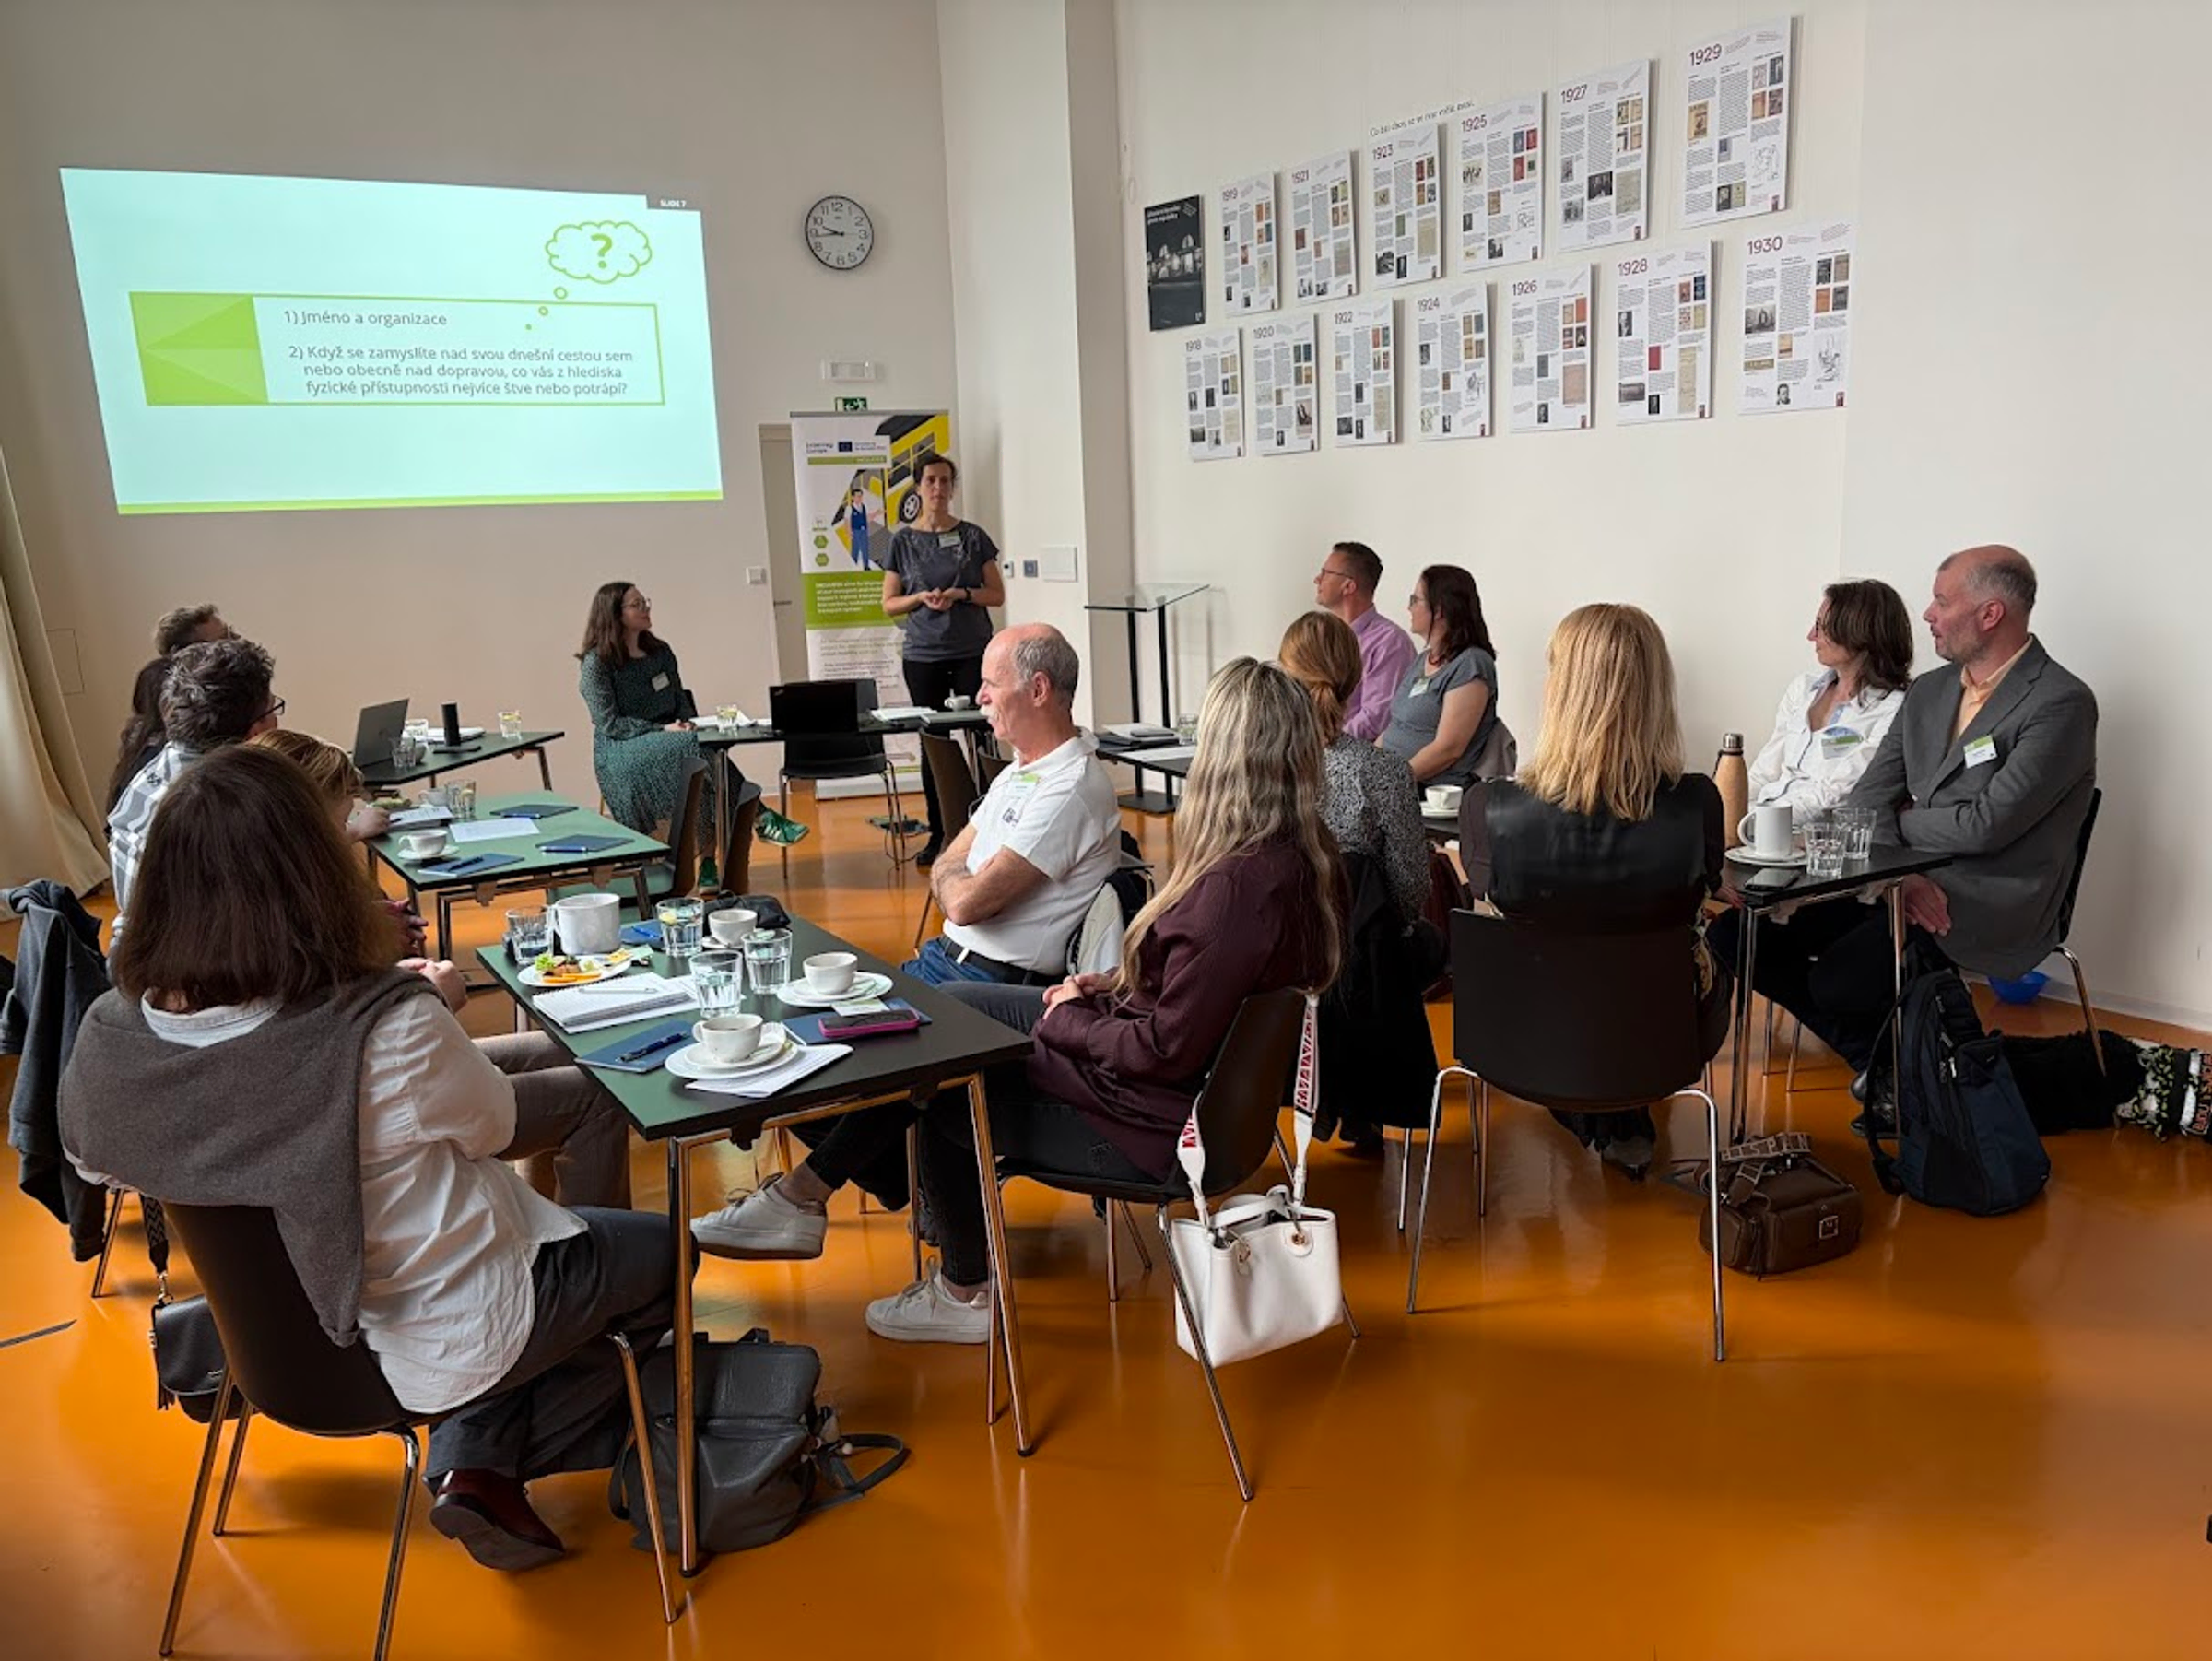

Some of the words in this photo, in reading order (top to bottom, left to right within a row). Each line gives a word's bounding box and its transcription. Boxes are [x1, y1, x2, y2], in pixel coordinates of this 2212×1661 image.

[1690, 43, 1722, 66] 1929
[1561, 84, 1587, 104] 1927
[1462, 114, 1487, 133] 1925
[1372, 144, 1394, 160] 1923
[1292, 170, 1309, 184] 1921
[820, 205, 830, 216] 11
[831, 202, 843, 213] 12
[812, 216, 823, 227] 10
[853, 216, 865, 227] 2
[858, 229, 868, 240] 3
[814, 241, 823, 252] 8
[1747, 235, 1783, 255] 1930
[824, 251, 832, 262] 7
[848, 252, 857, 263] 5
[1618, 258, 1648, 277] 1928
[1512, 280, 1537, 296] 1926
[1418, 297, 1440, 312] 1924
[284, 311, 298, 325] 1)
[301, 310, 350, 325] Jméno
[355, 314, 363, 324] a
[368, 312, 447, 328] organizace
[1335, 311, 1353, 324] 1922
[1253, 325, 1275, 339] 1920
[288, 346, 304, 359] 2)
[307, 346, 344, 362] Když
[347, 348, 364, 359] se
[369, 346, 437, 362] zamyslíte
[441, 348, 467, 359] nad
[471, 350, 505, 360] svou
[508, 348, 554, 361] dnešní
[557, 350, 602, 361] cestou
[605, 352, 633, 361] sem
[304, 364, 344, 376] nebo
[347, 363, 402, 376] obecně
[406, 364, 433, 376] nad
[437, 364, 508, 379] dopravou,
[512, 368, 527, 378] co
[531, 366, 553, 378] vás
[557, 369, 564, 378] z
[567, 366, 622, 378] hlediska
[306, 380, 357, 397] fyzické
[360, 381, 449, 396] přístupnosti
[453, 382, 500, 397] nejvíce
[504, 381, 533, 395] štve
[535, 383, 571, 395] nebo
[573, 383, 628, 397] potrápí?
